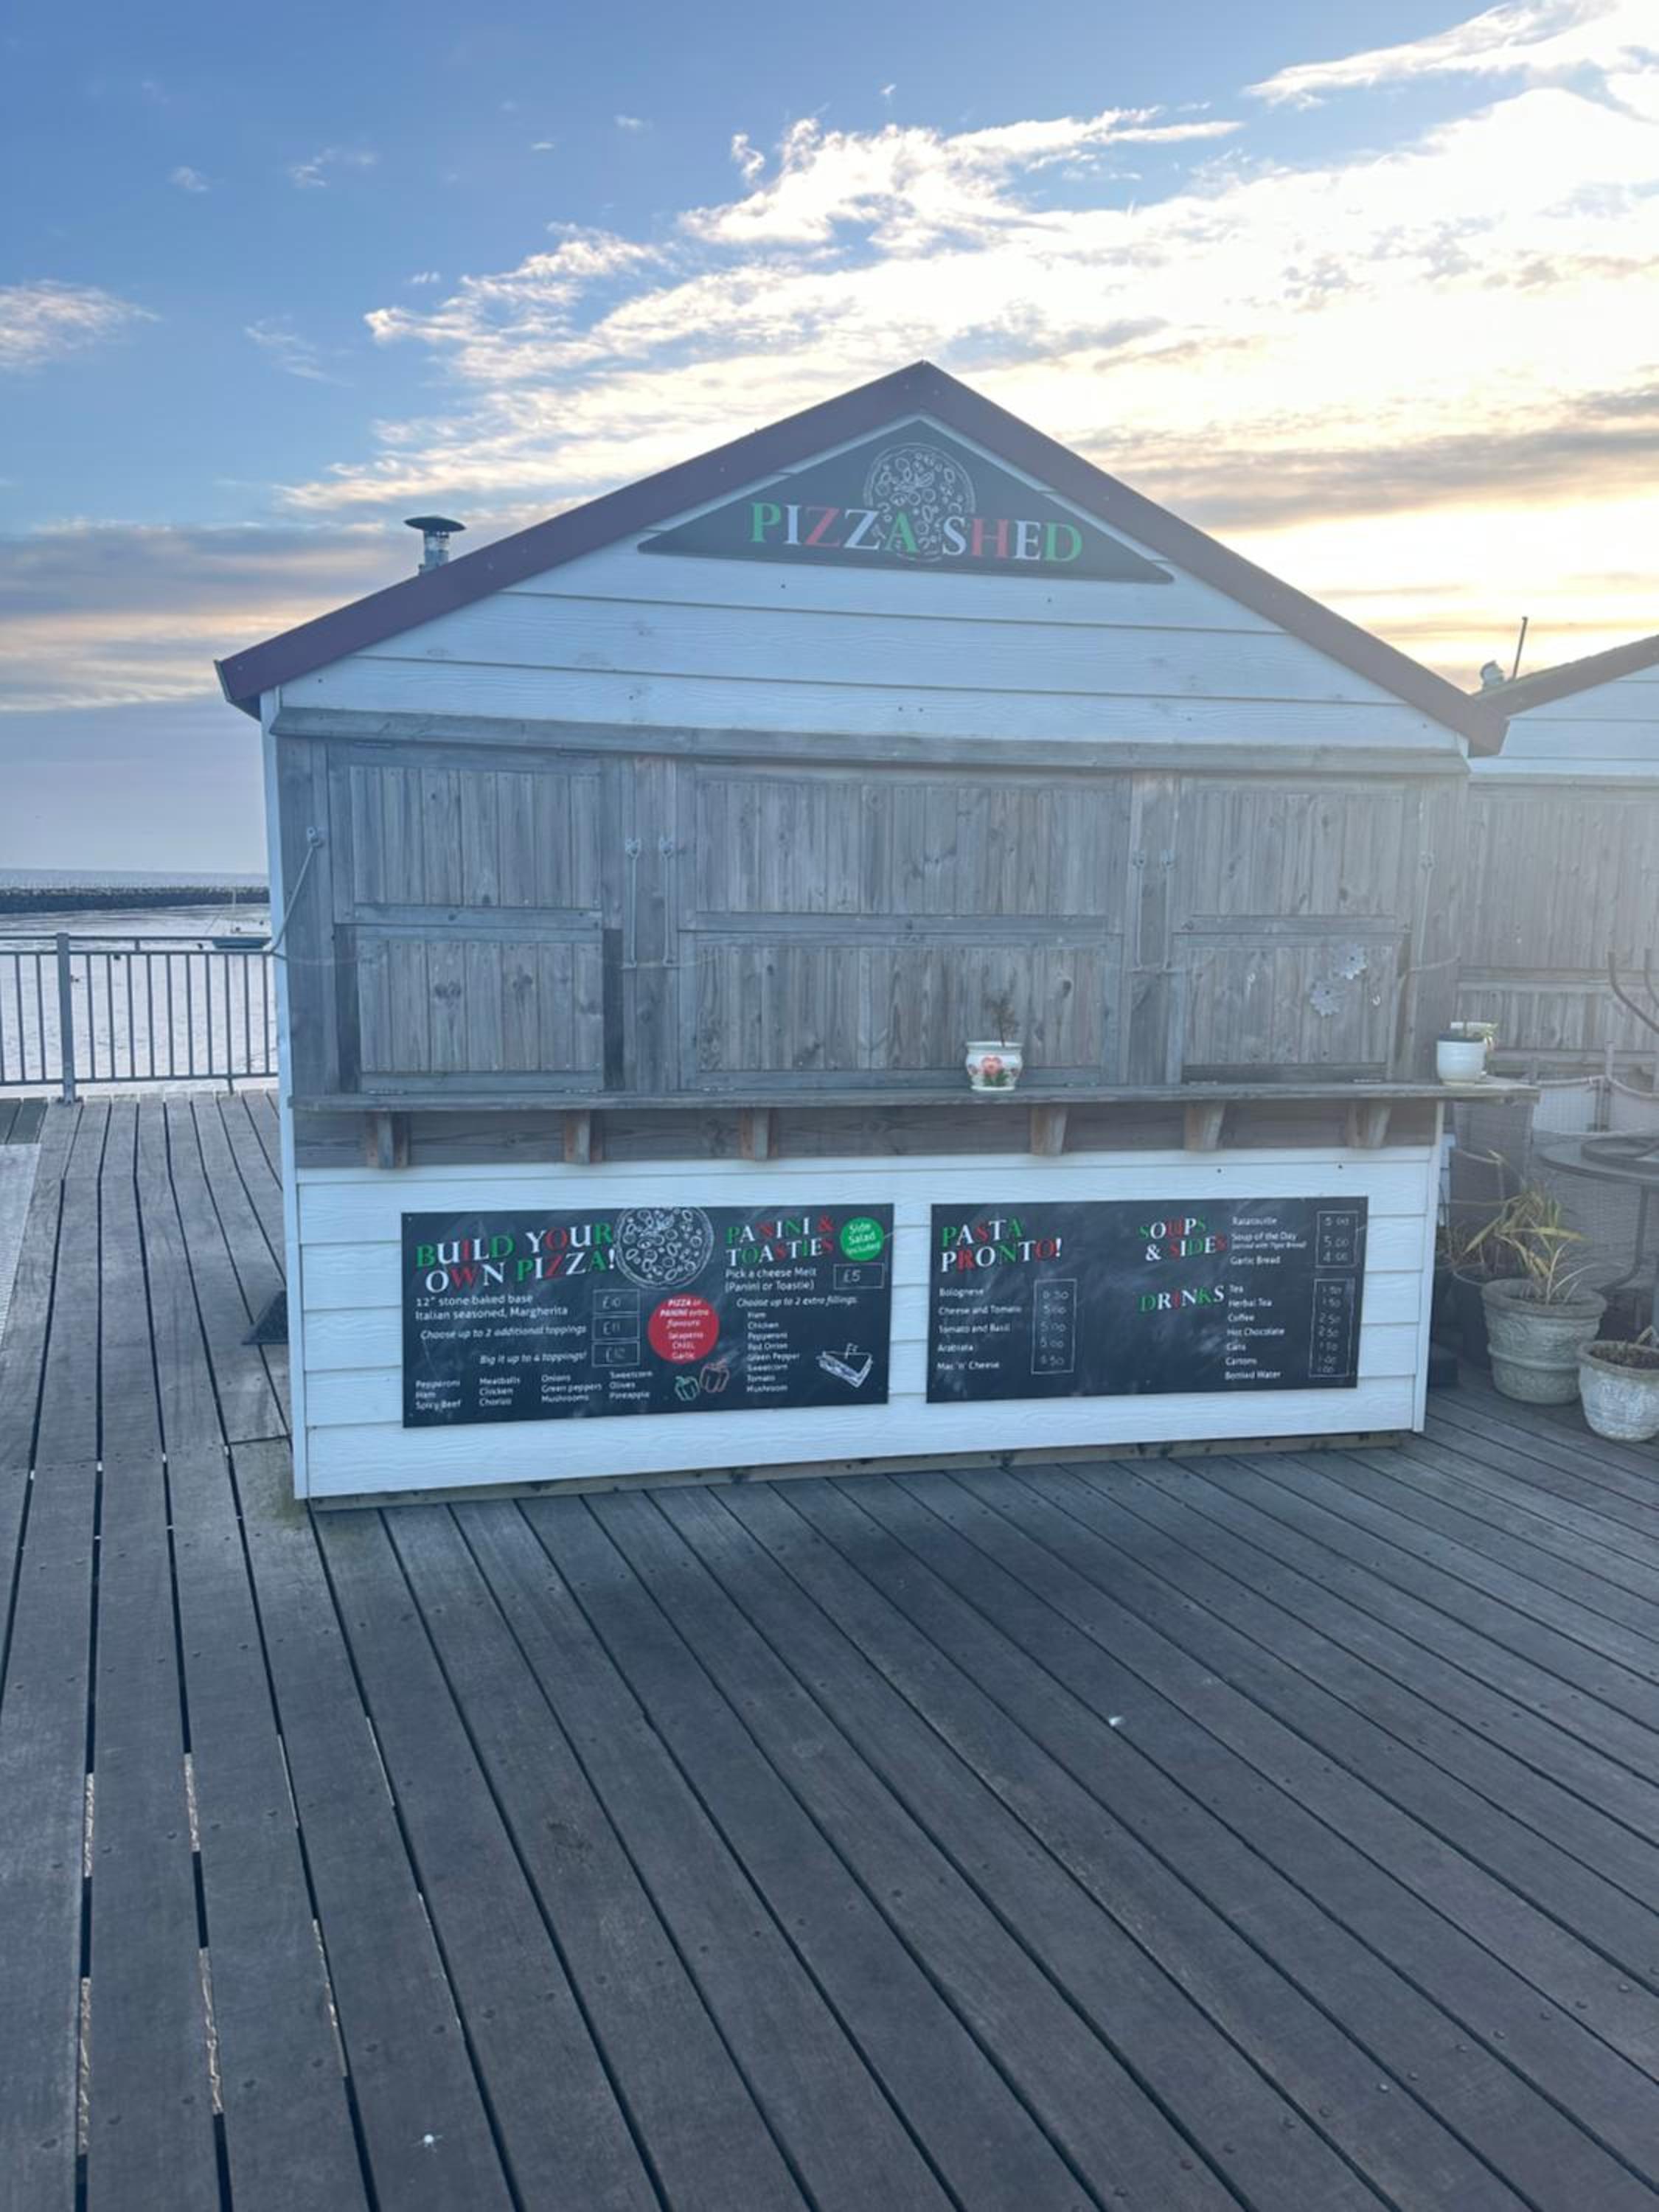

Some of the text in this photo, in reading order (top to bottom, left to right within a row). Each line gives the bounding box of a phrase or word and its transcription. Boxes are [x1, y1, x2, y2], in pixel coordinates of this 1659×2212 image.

[750, 502, 1084, 562] PIZZA SHED
[727, 1215, 835, 1245] PANINI &
[849, 1221, 872, 1234] Side
[942, 1217, 1023, 1248] PASTA
[1138, 1217, 1207, 1239] SOUPS
[848, 1231, 876, 1245] Salad
[1231, 1231, 1298, 1243] Soup of the Day
[417, 1222, 613, 1268] BUILD YOUR
[1145, 1234, 1228, 1262] & SIDES
[726, 1236, 835, 1267] TOASTIES
[941, 1238, 1062, 1273] PRONTO!
[1256, 1254, 1281, 1265] Bread
[425, 1248, 615, 1293] OWN PIZZA!
[725, 1266, 745, 1280] Pick
[748, 1269, 755, 1279] a
[757, 1267, 793, 1279] cheese
[762, 1282, 773, 1291] or
[939, 1287, 984, 1298] Bolognese
[1229, 1284, 1244, 1293] Tea
[508, 1294, 534, 1305] base
[770, 1298, 782, 1308] up
[1139, 1284, 1225, 1312] DRINKS
[1228, 1297, 1273, 1307] Herbal Tea
[414, 1309, 451, 1321] Italian
[509, 1305, 568, 1319] Margherita
[938, 1304, 1023, 1315] Cheese and Tomato
[1228, 1312, 1256, 1322] Coffee
[747, 1321, 779, 1330] Chicken
[971, 1324, 988, 1333] and
[420, 1328, 456, 1340] Choose
[458, 1329, 472, 1340] up
[473, 1329, 484, 1339] to
[1243, 1326, 1286, 1338] Chocolate
[936, 1361, 953, 1371] Mac
[968, 1360, 1001, 1371] Cheese
[540, 1373, 571, 1383] Onions
[609, 1370, 653, 1380] Sweetcorn
[415, 1379, 461, 1391] Pepperoni
[415, 1391, 437, 1399] Ham
[479, 1386, 514, 1397] Chicken
[541, 1393, 590, 1403] Mushrooms
